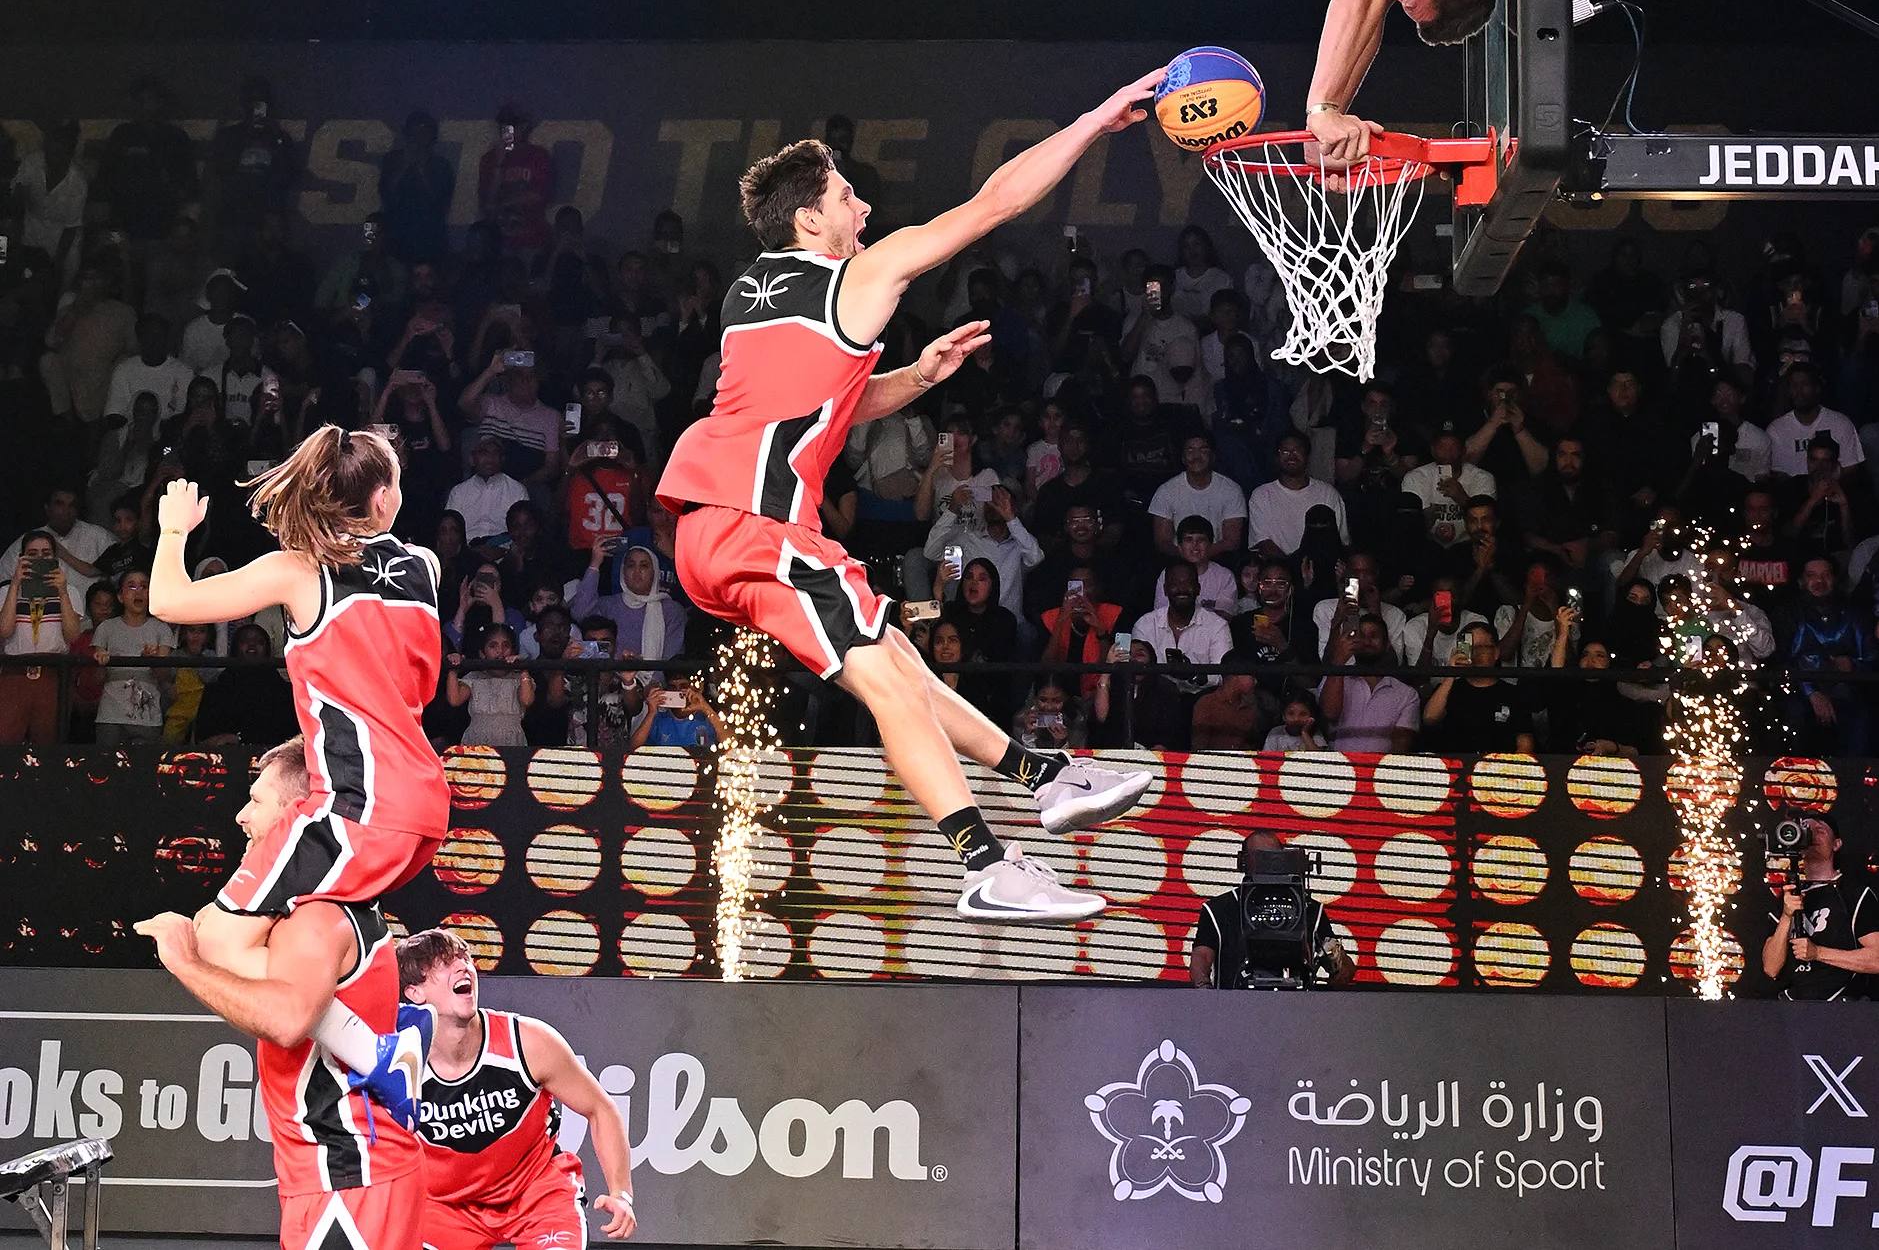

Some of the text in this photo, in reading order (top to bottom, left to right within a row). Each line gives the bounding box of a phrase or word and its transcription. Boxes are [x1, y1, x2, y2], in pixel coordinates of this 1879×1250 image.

[582, 492, 626, 532] 32
[1738, 559, 1787, 583] MARVEL
[139, 1078, 188, 1130] to
[419, 1087, 521, 1123] Dunking
[427, 1109, 506, 1141] Devils
[1288, 1077, 1604, 1143] وزارة الرياضة
[1288, 1146, 1606, 1199] Ministry of Sport
[1722, 1145, 1879, 1229] @F
